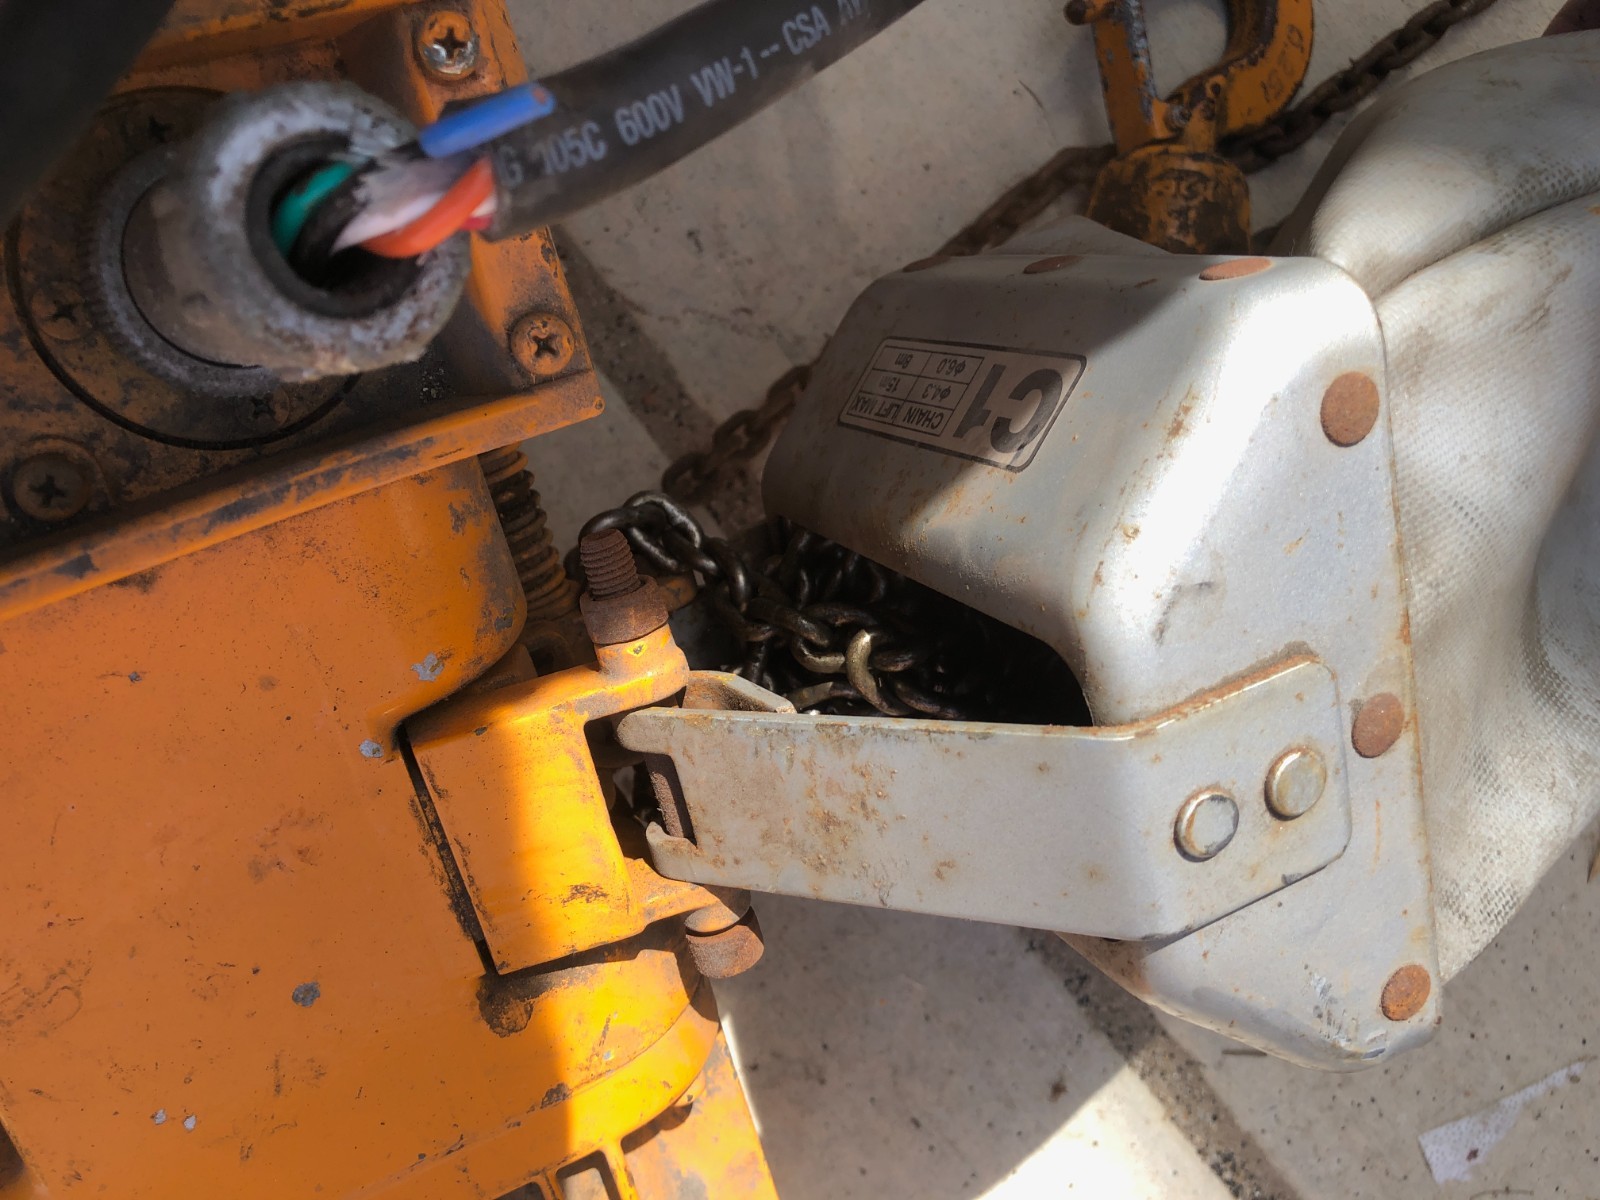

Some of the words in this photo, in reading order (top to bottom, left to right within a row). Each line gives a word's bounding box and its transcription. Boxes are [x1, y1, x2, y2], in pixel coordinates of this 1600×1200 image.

[529, 121, 607, 175] 105C
[615, 84, 684, 146] 600V
[781, 3, 831, 56] CSA
[850, 395, 876, 415] MAX
[875, 401, 901, 420] LIFT
[953, 364, 1063, 453] C1
[902, 406, 944, 430] CHAIN
